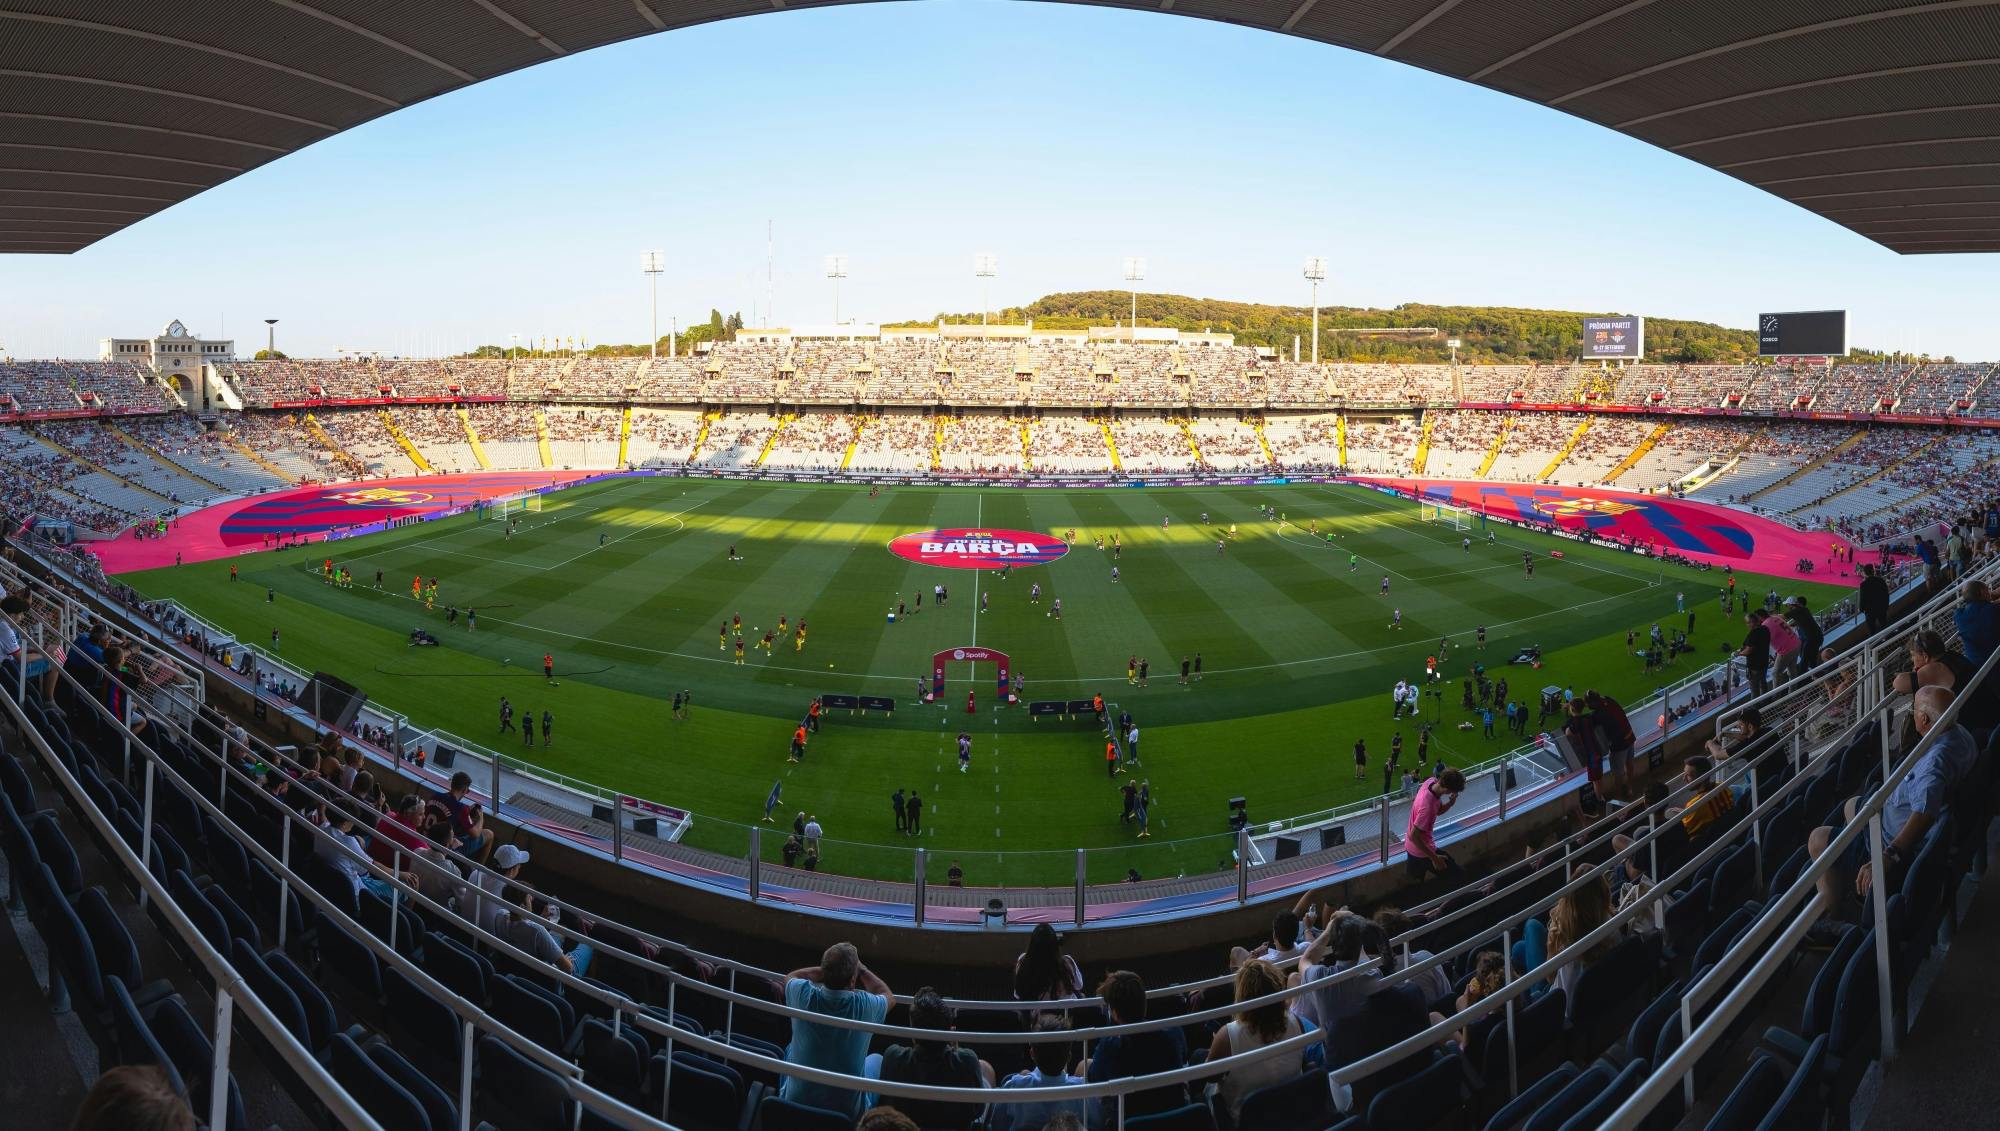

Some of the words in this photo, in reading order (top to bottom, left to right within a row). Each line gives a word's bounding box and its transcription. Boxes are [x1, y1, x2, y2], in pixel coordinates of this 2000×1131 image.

[1612, 321, 1631, 329] PARTIT
[1552, 530, 1578, 540] AMBILIGHT
[921, 542, 1040, 555] BARÇA
[1590, 538, 1619, 549] AMBILIGHT
